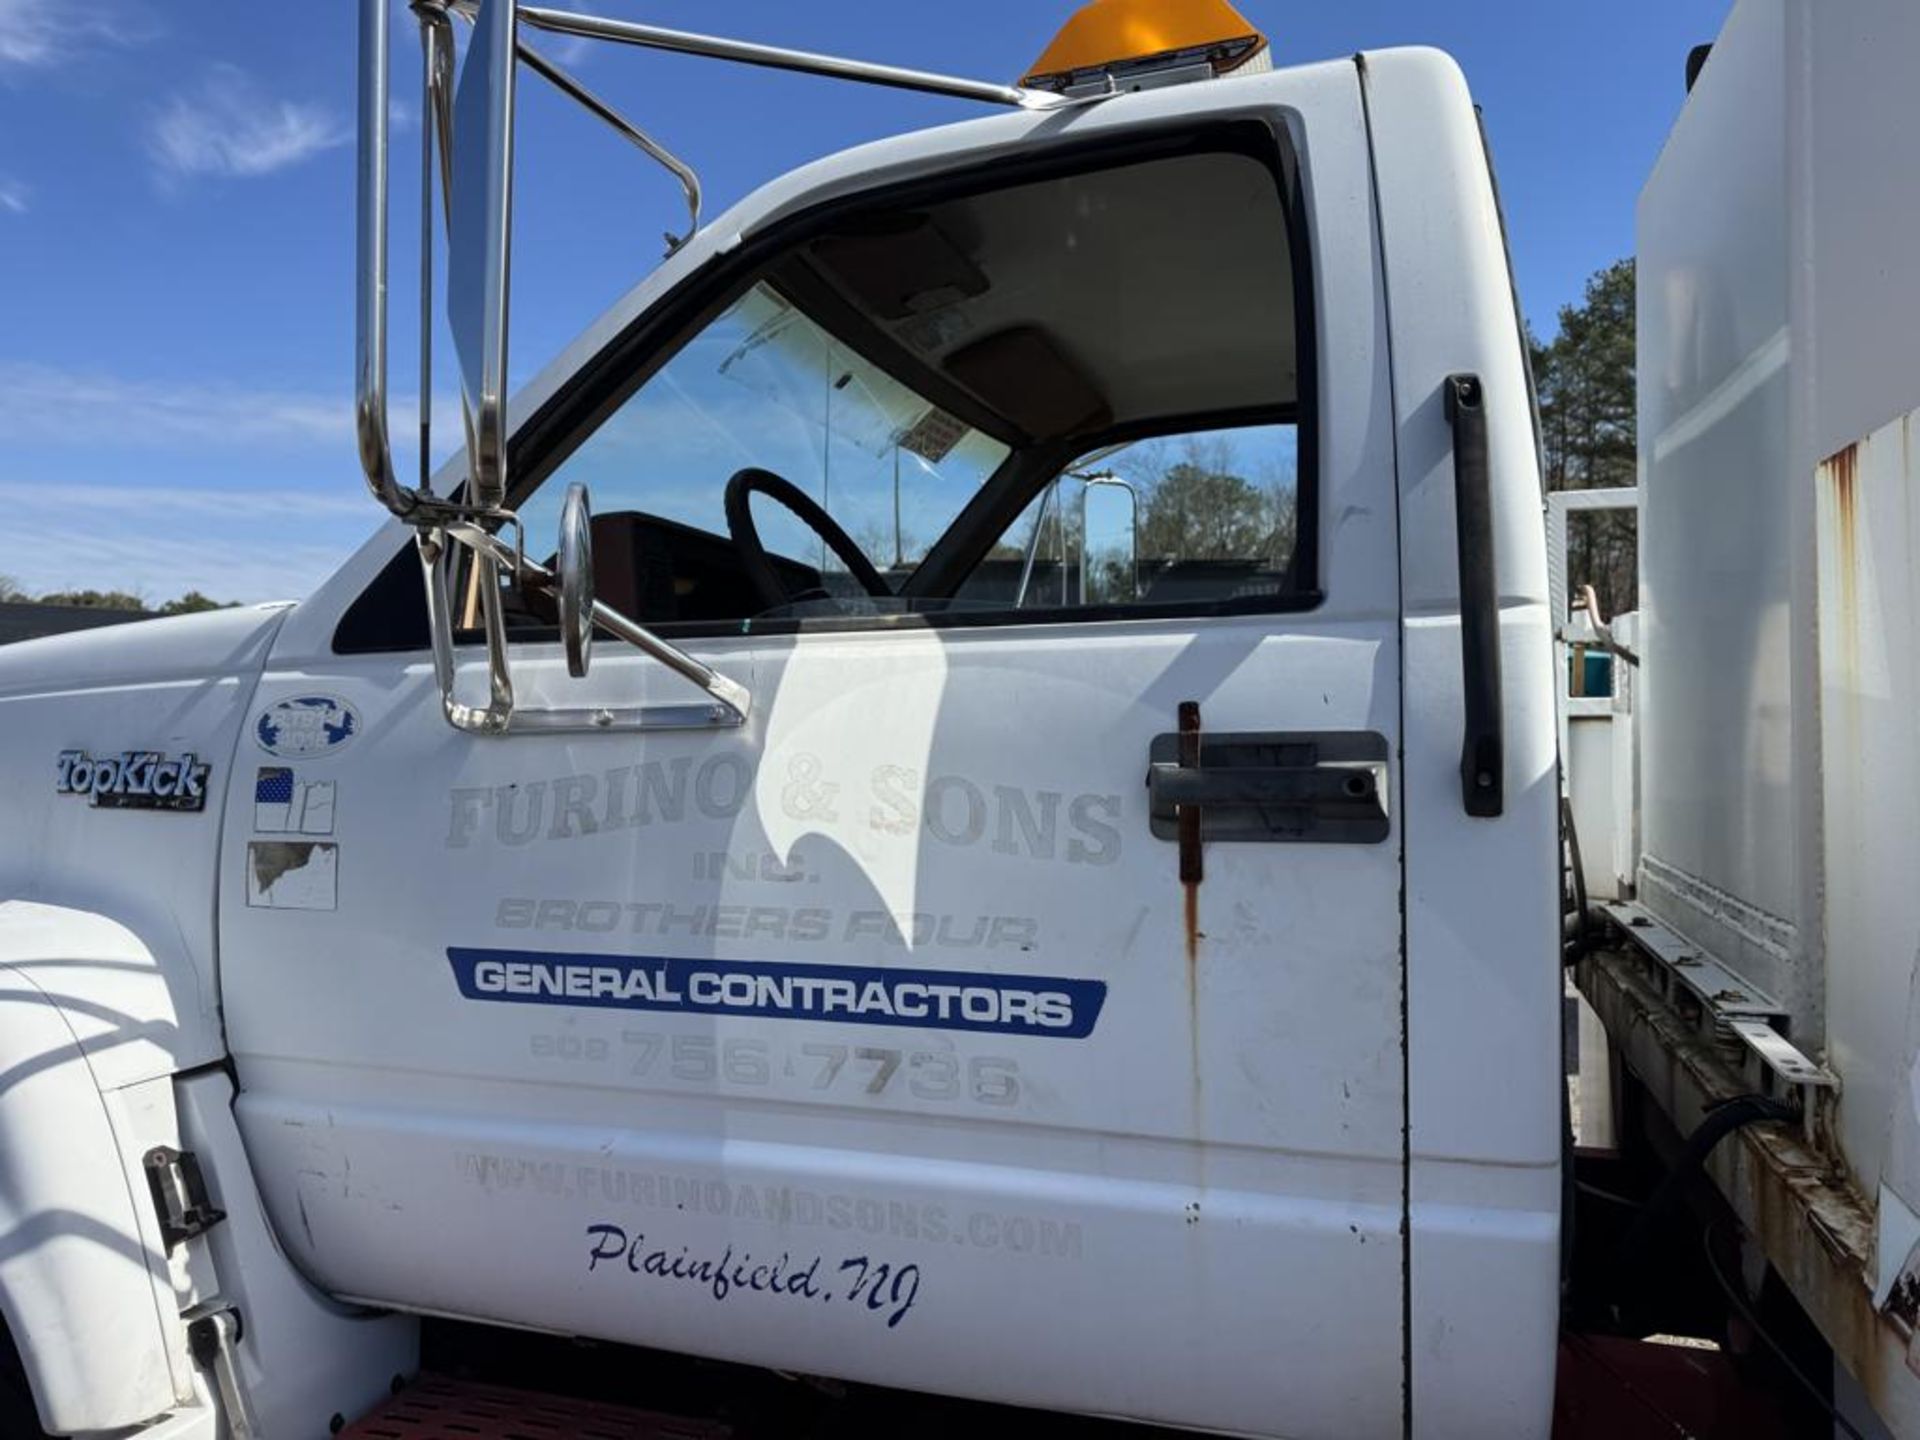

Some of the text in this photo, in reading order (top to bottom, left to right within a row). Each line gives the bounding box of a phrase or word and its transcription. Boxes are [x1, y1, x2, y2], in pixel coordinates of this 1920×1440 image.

[57, 750, 207, 807] TopKick
[445, 752, 1123, 867] FURINO & SONS
[692, 851, 821, 883] INC.
[495, 898, 1039, 951] BROTHERS FOUR
[474, 961, 1073, 1028] GENERAL CONTRACTORS
[839, 1256, 920, 1327] NJ
